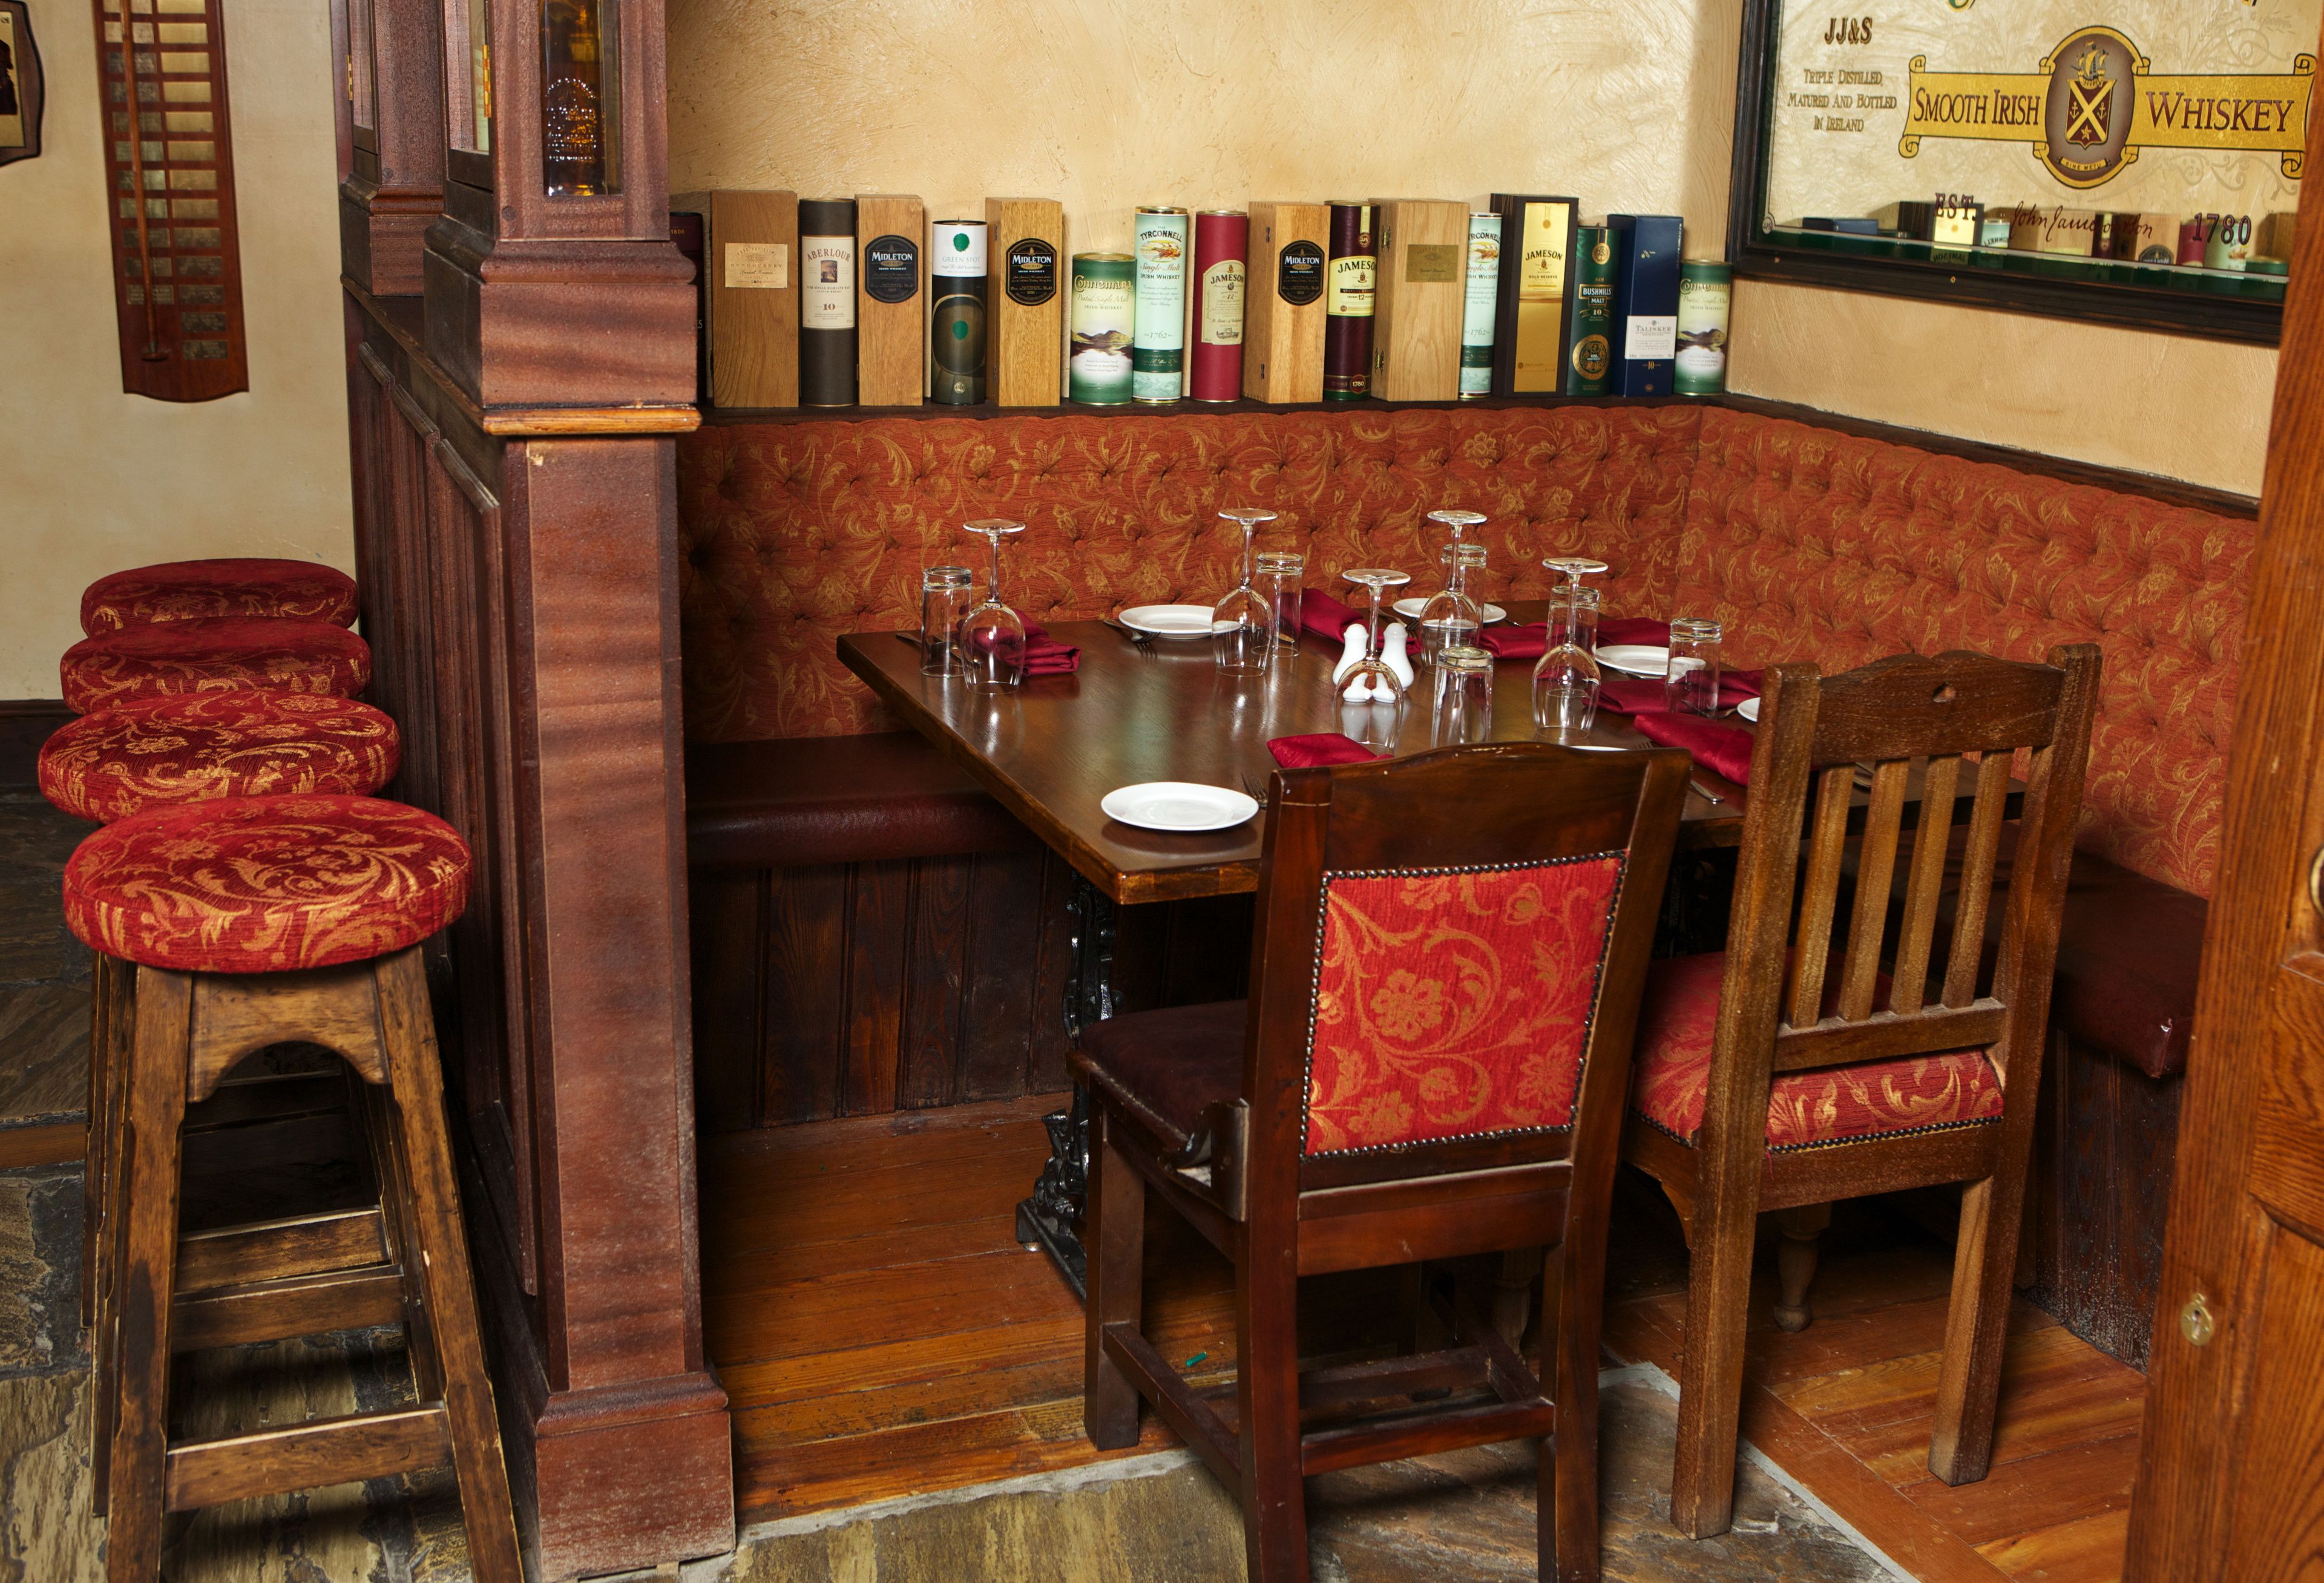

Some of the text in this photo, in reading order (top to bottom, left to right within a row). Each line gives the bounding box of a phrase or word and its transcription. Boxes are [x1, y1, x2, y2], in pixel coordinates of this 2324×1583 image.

[1824, 17, 1873, 44] JJ&S
[1804, 69, 1834, 84] TRIPLE
[1787, 93, 1897, 109] MATURED AND BOTTLED
[1914, 87, 2295, 132] SMOOTH IRISH WHISKEY
[1814, 116, 1865, 132] IN IRELAND
[1934, 192, 1976, 221] EST.
[2192, 212, 2251, 245] 1780
[1140, 230, 1183, 243] TYRCONNELL
[807, 248, 850, 262] ABERLOUR
[872, 252, 913, 261] MIDLETON
[1012, 255, 1052, 264] MIDLETON
[1284, 255, 1319, 265] MIDLETON
[1525, 249, 1562, 261] JAMESON
[1338, 260, 1376, 273] JAMESO
[1074, 275, 1134, 293] Connemara
[1210, 274, 1244, 284] JAMESON
[1149, 330, 1167, 341] 1762
